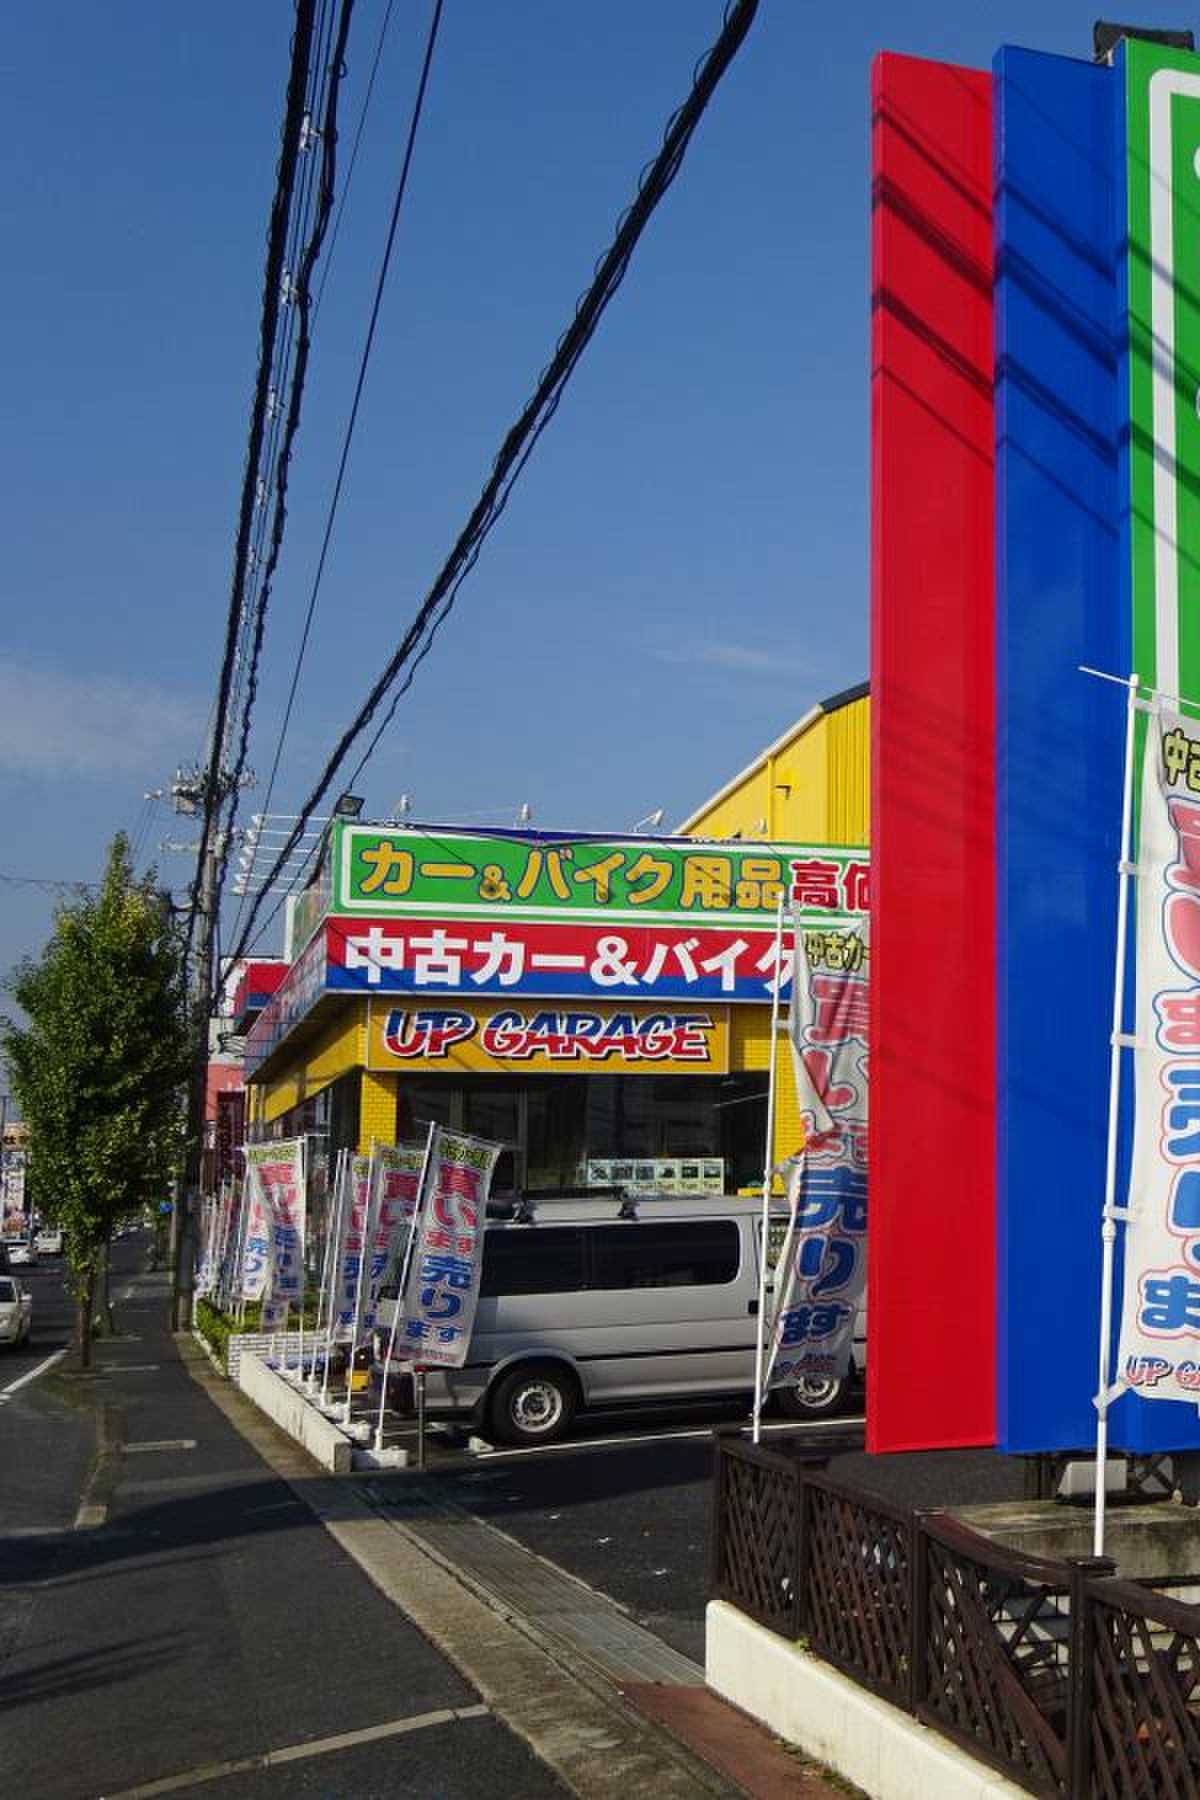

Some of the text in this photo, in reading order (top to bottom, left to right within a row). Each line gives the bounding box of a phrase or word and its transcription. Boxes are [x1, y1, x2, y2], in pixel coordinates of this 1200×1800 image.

[804, 931, 869, 972] 中古カ
[382, 1007, 718, 1064] UP GARAGE
[1125, 1355, 1173, 1390] UP
